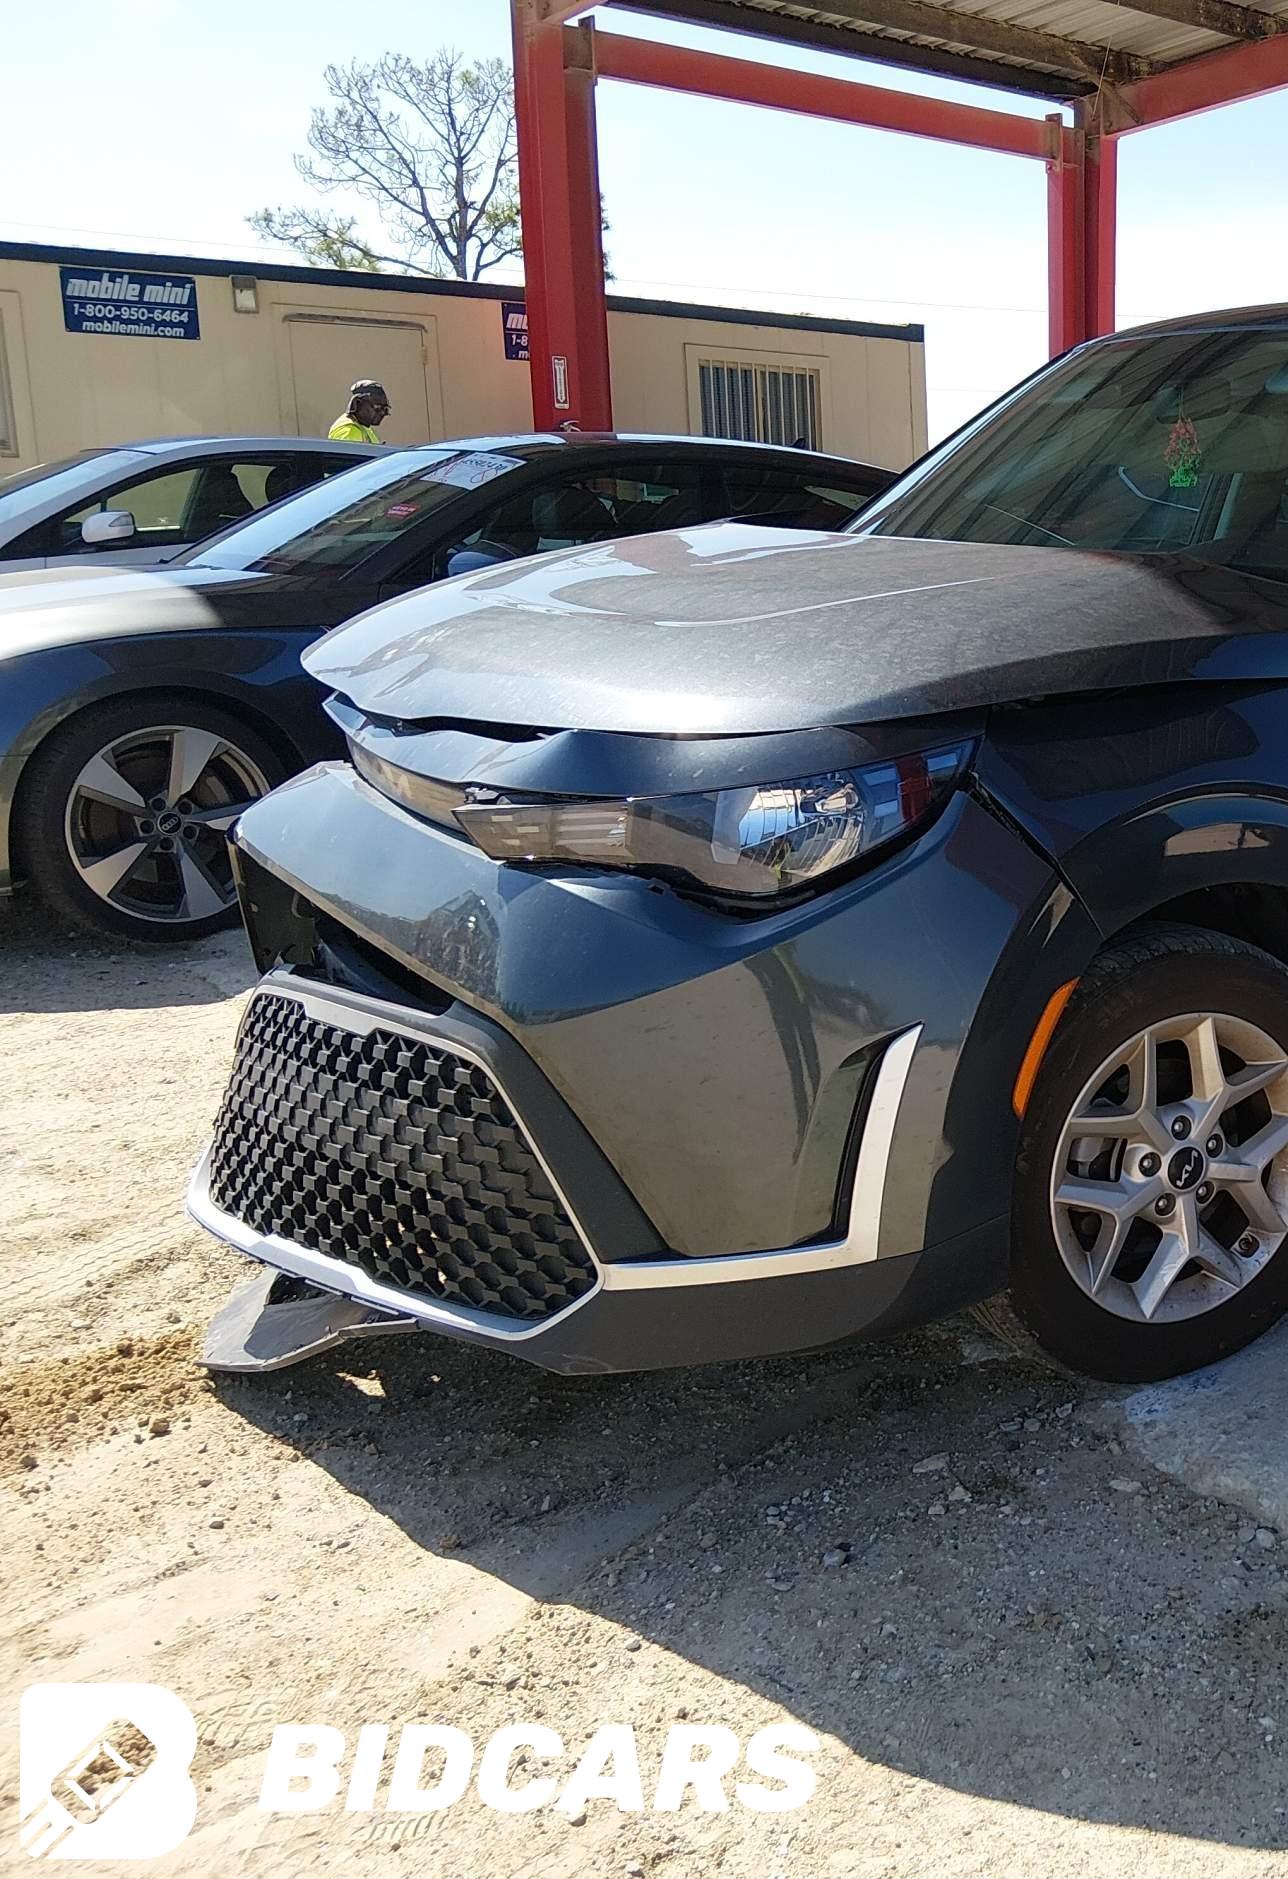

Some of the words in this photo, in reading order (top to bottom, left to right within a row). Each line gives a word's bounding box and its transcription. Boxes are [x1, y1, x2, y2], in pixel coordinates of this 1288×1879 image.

[66, 272, 140, 301] mobile
[143, 281, 191, 305] mini
[73, 303, 189, 323] 1-800-950-6464
[82, 320, 185, 337] mobilemini.com
